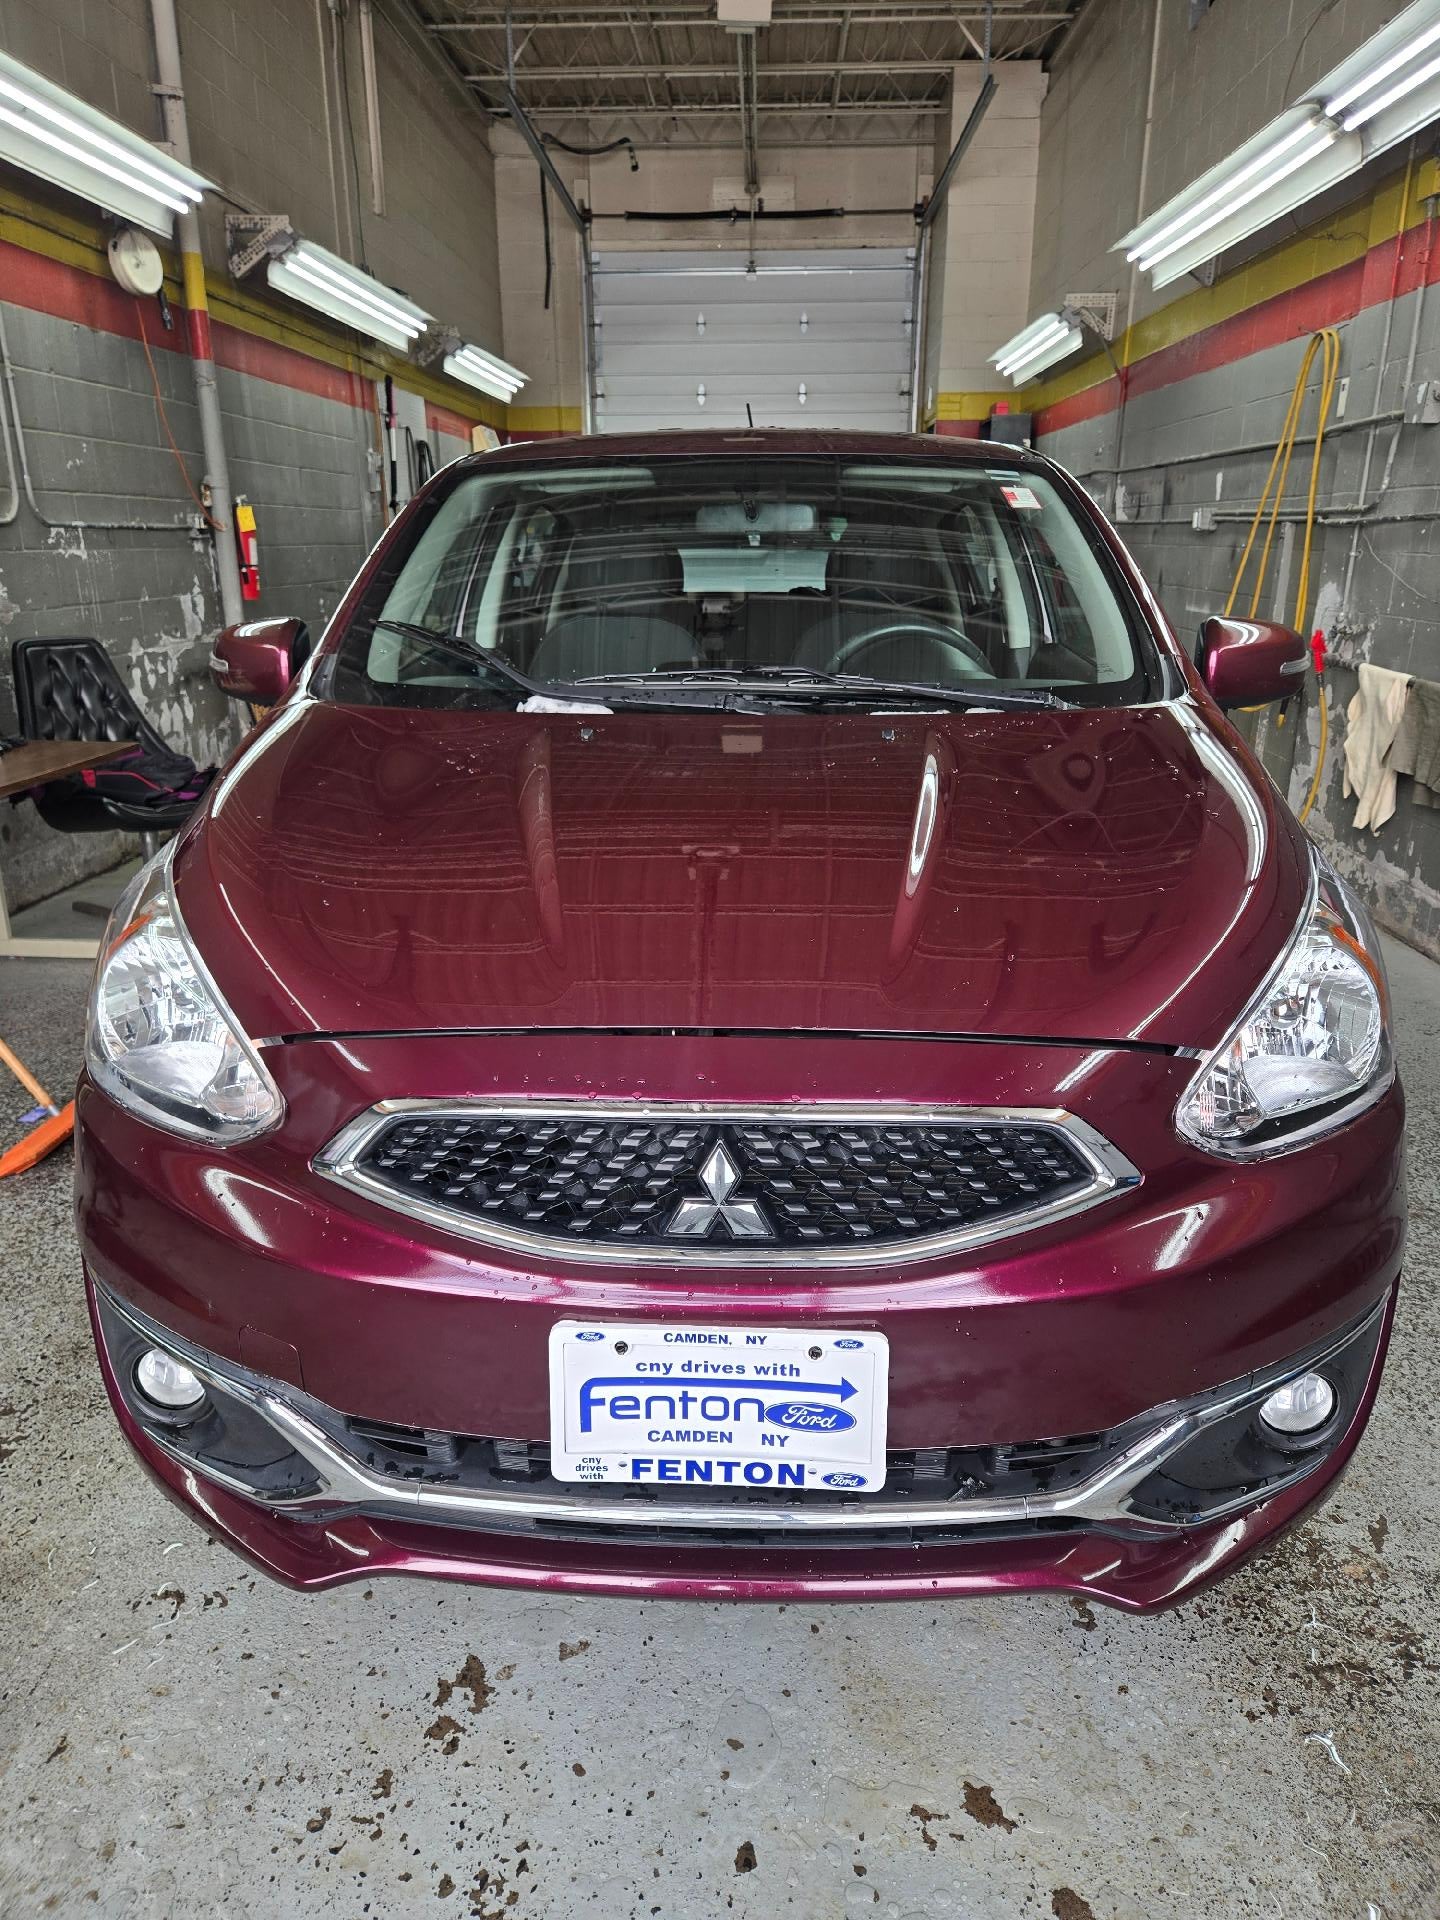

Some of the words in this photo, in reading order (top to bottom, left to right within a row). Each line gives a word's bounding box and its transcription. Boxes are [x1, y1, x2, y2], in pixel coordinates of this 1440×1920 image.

[745, 1335, 768, 1345] NY
[839, 1339, 859, 1349] Ford
[635, 1362, 673, 1375] cny
[681, 1360, 746, 1374] drives
[753, 1363, 800, 1377] with
[782, 1404, 838, 1429] Ford
[647, 1430, 733, 1443] CAMDEN
[761, 1433, 790, 1447] NY
[582, 1457, 602, 1465] cny
[575, 1464, 609, 1472] drives
[631, 1458, 805, 1486] FENTON
[830, 1474, 858, 1487] Ford
[580, 1472, 604, 1480] with
